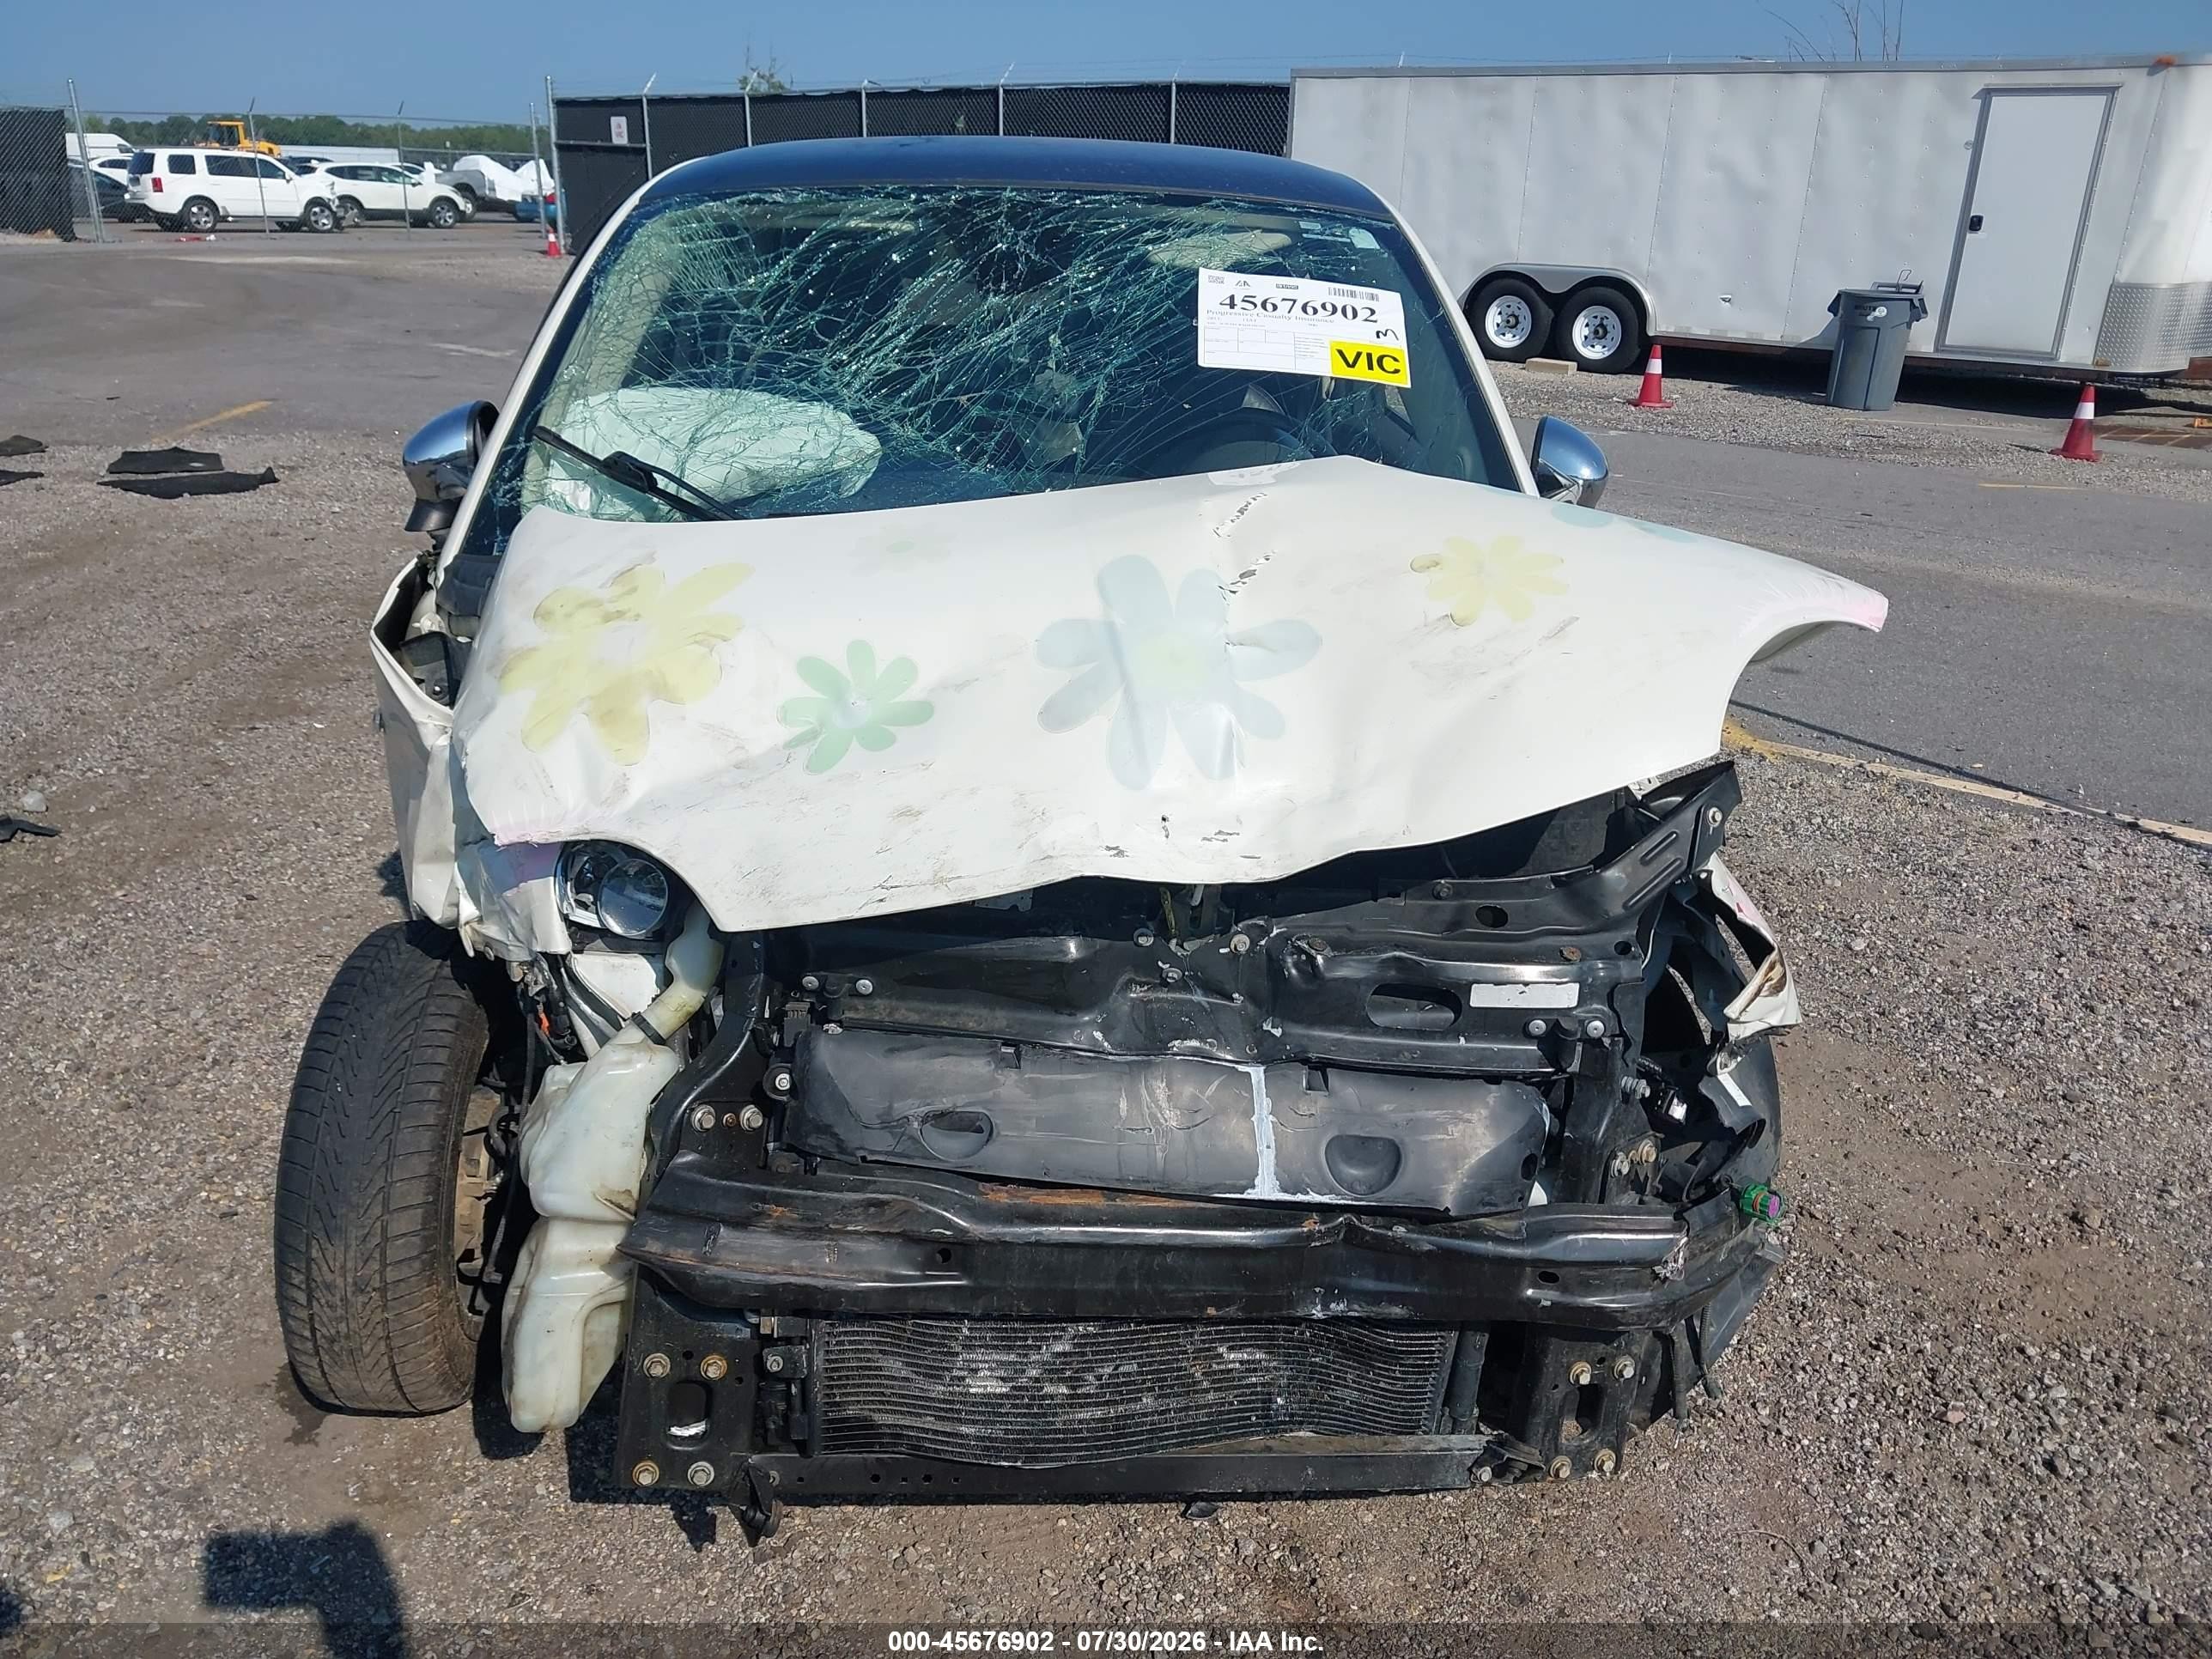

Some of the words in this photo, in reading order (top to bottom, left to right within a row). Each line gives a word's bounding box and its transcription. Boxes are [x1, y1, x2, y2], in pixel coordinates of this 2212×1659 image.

[1206, 309, 1255, 318] Progressive
[1219, 294, 1378, 324] 45676902
[1335, 348, 1401, 374] VIC
